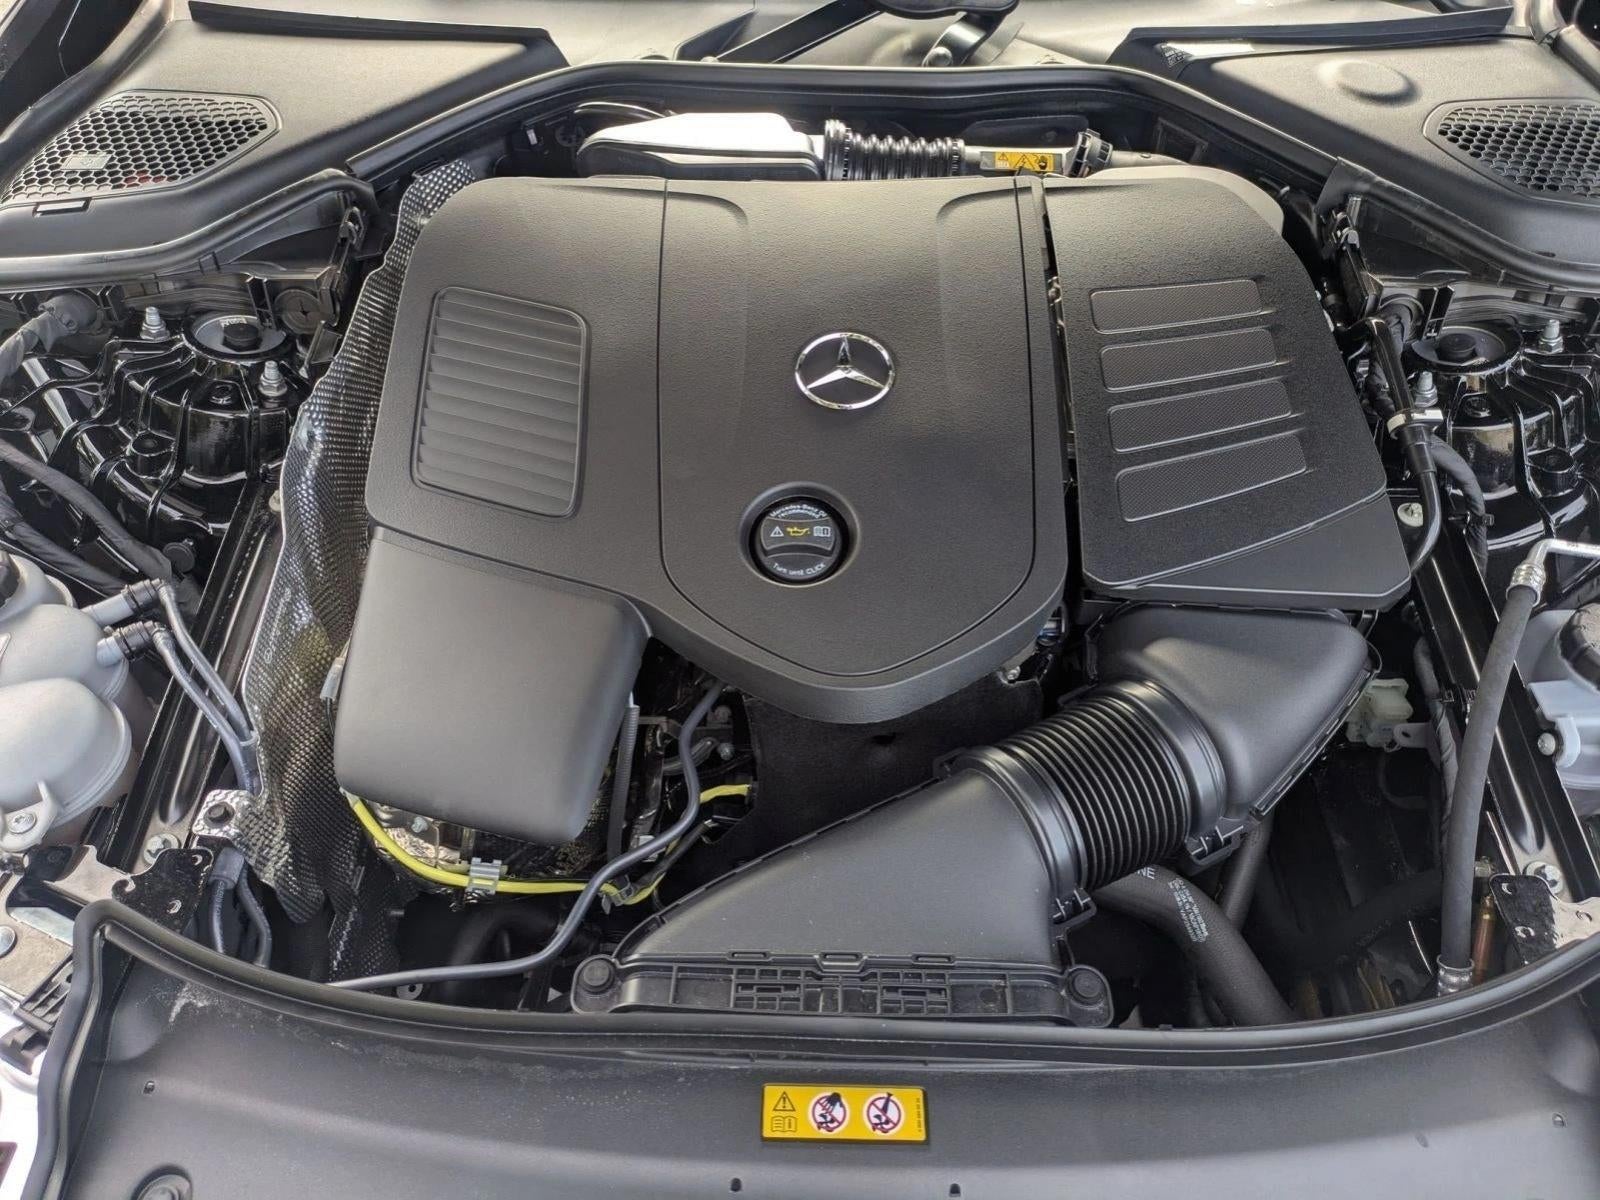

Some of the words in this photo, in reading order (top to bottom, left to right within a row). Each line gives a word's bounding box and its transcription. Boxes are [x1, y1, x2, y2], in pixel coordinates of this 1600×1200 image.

[773, 563, 787, 573] Turn
[789, 568, 804, 576] until
[805, 563, 826, 575] CLICK
